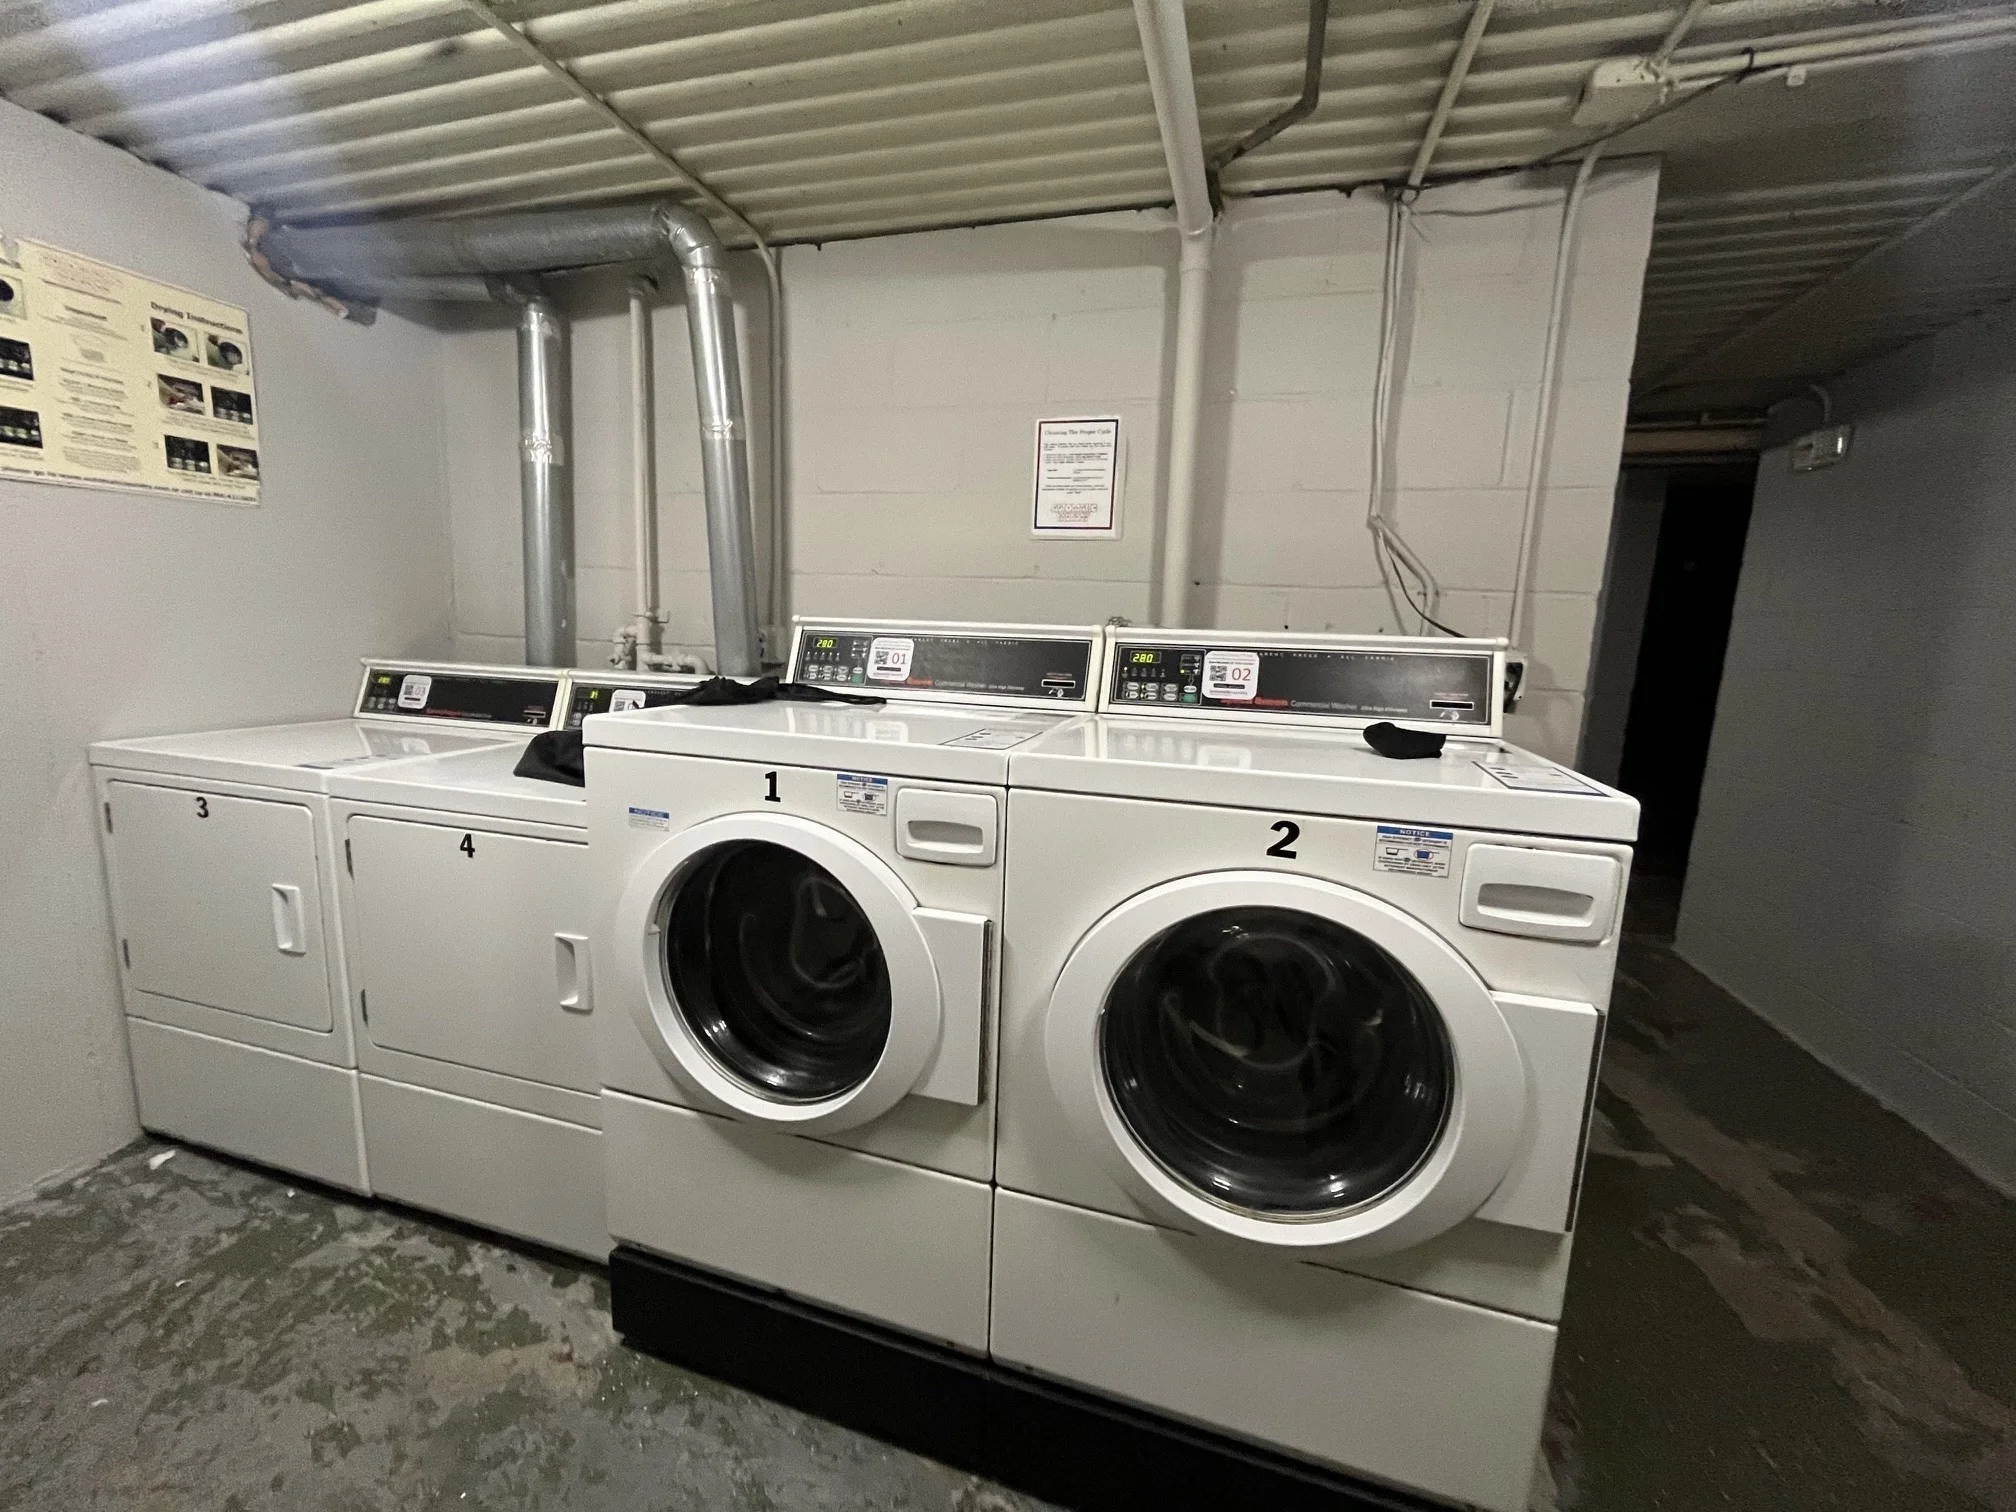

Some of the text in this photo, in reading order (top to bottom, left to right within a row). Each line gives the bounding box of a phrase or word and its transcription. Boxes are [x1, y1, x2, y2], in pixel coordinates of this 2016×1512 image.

[150, 301, 242, 334] Drying Instructions
[892, 652, 907, 665] 01
[1132, 653, 1154, 662] 280
[1232, 668, 1251, 682] 02
[1290, 700, 1330, 708] Commercial
[1331, 702, 1357, 710] Washer
[764, 770, 781, 802] 1
[197, 796, 209, 818] 3
[1266, 820, 1300, 860] 2
[1399, 829, 1430, 837] NOTICE
[460, 833, 476, 858] 4
